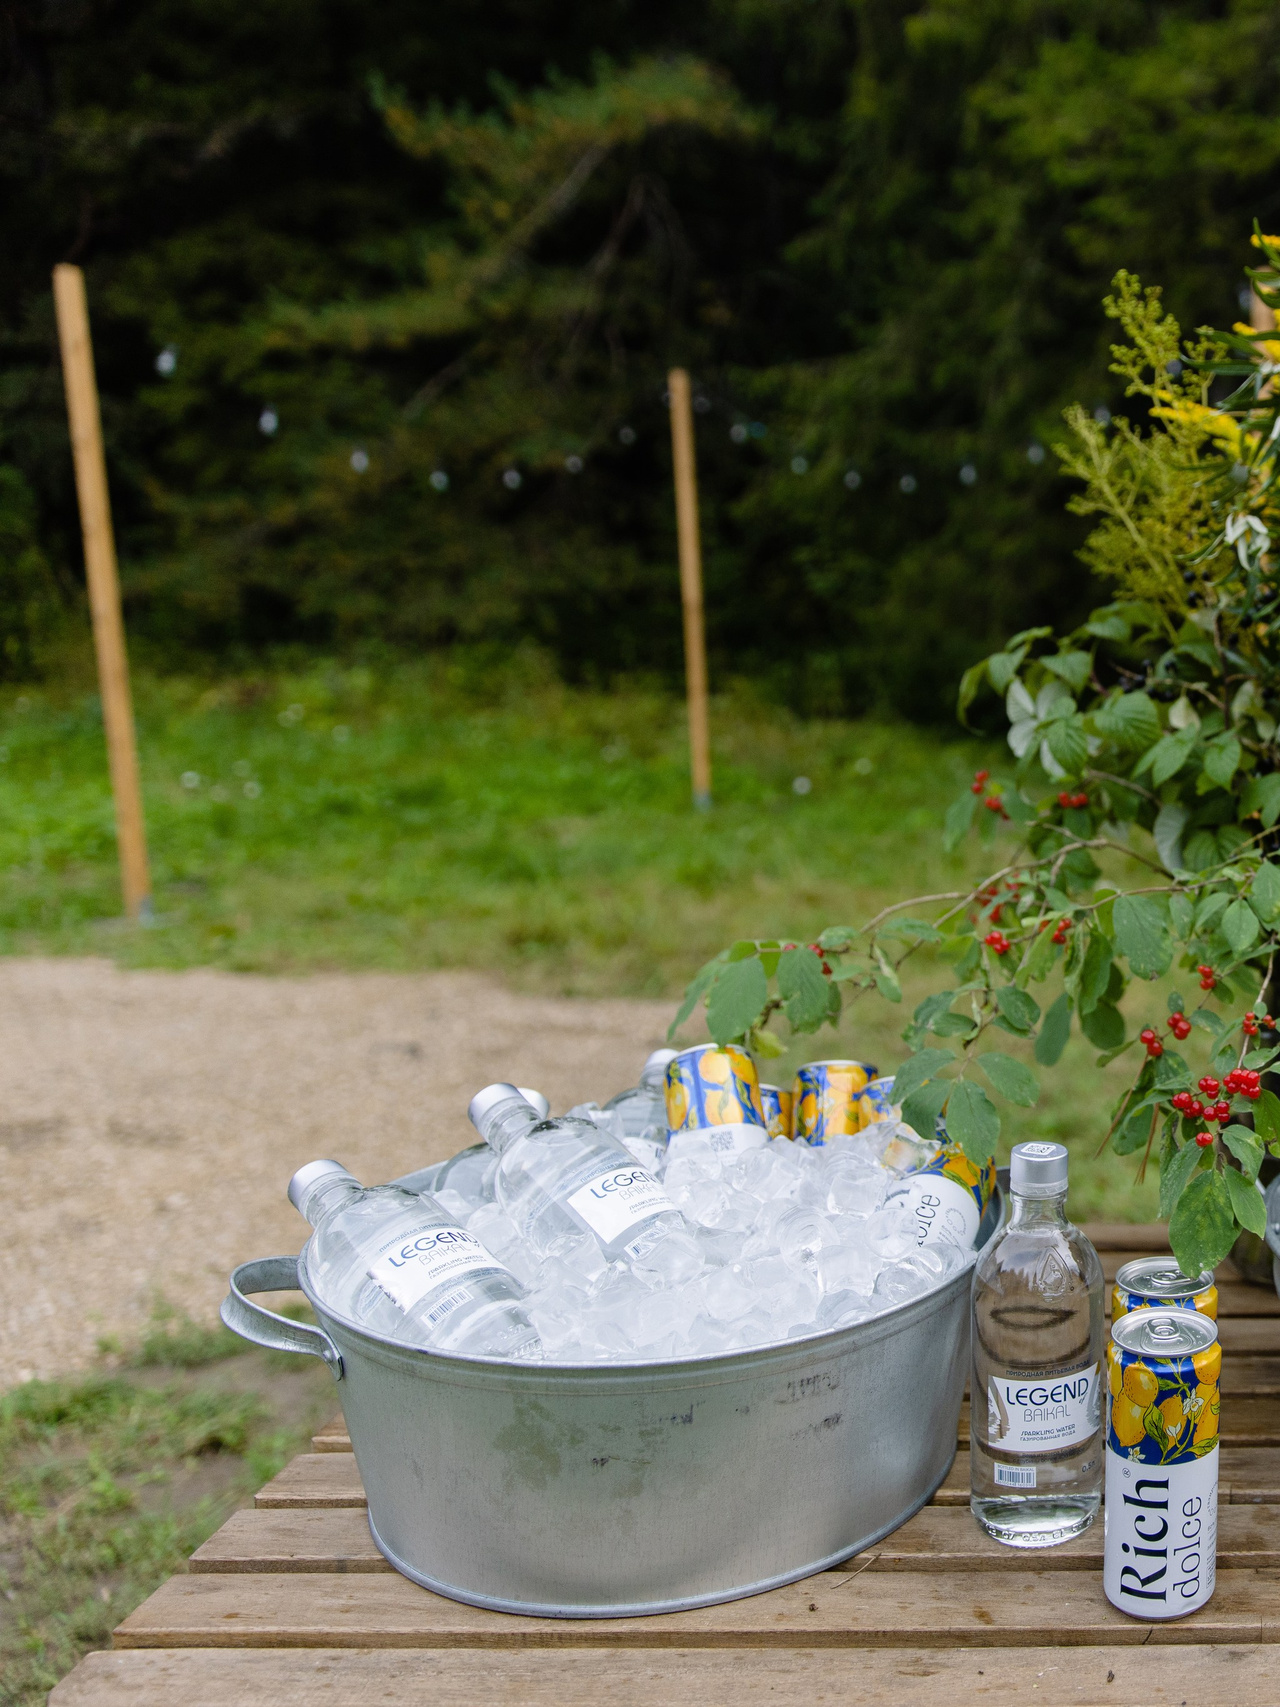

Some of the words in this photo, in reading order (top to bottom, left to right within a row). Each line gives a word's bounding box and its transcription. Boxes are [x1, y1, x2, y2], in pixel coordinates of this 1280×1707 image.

[388, 1231, 479, 1268] LEGEND
[418, 1243, 472, 1266] BAIKAL
[427, 1257, 463, 1276] SPARKLING
[1005, 1369, 1044, 1377] ПРИРОДНАЯ
[1044, 1365, 1075, 1377] ПИТЬЕВАЯ
[1006, 1377, 1089, 1406] LEGEND
[1023, 1405, 1071, 1422] BAIKAL
[1020, 1433, 1061, 1442] ГАЗИРОВАННАЯ
[1021, 1428, 1055, 1437] SPARKLING
[1056, 1423, 1076, 1433] WATER
[1120, 1476, 1169, 1604] Rich
[1173, 1496, 1202, 1599] dolce
